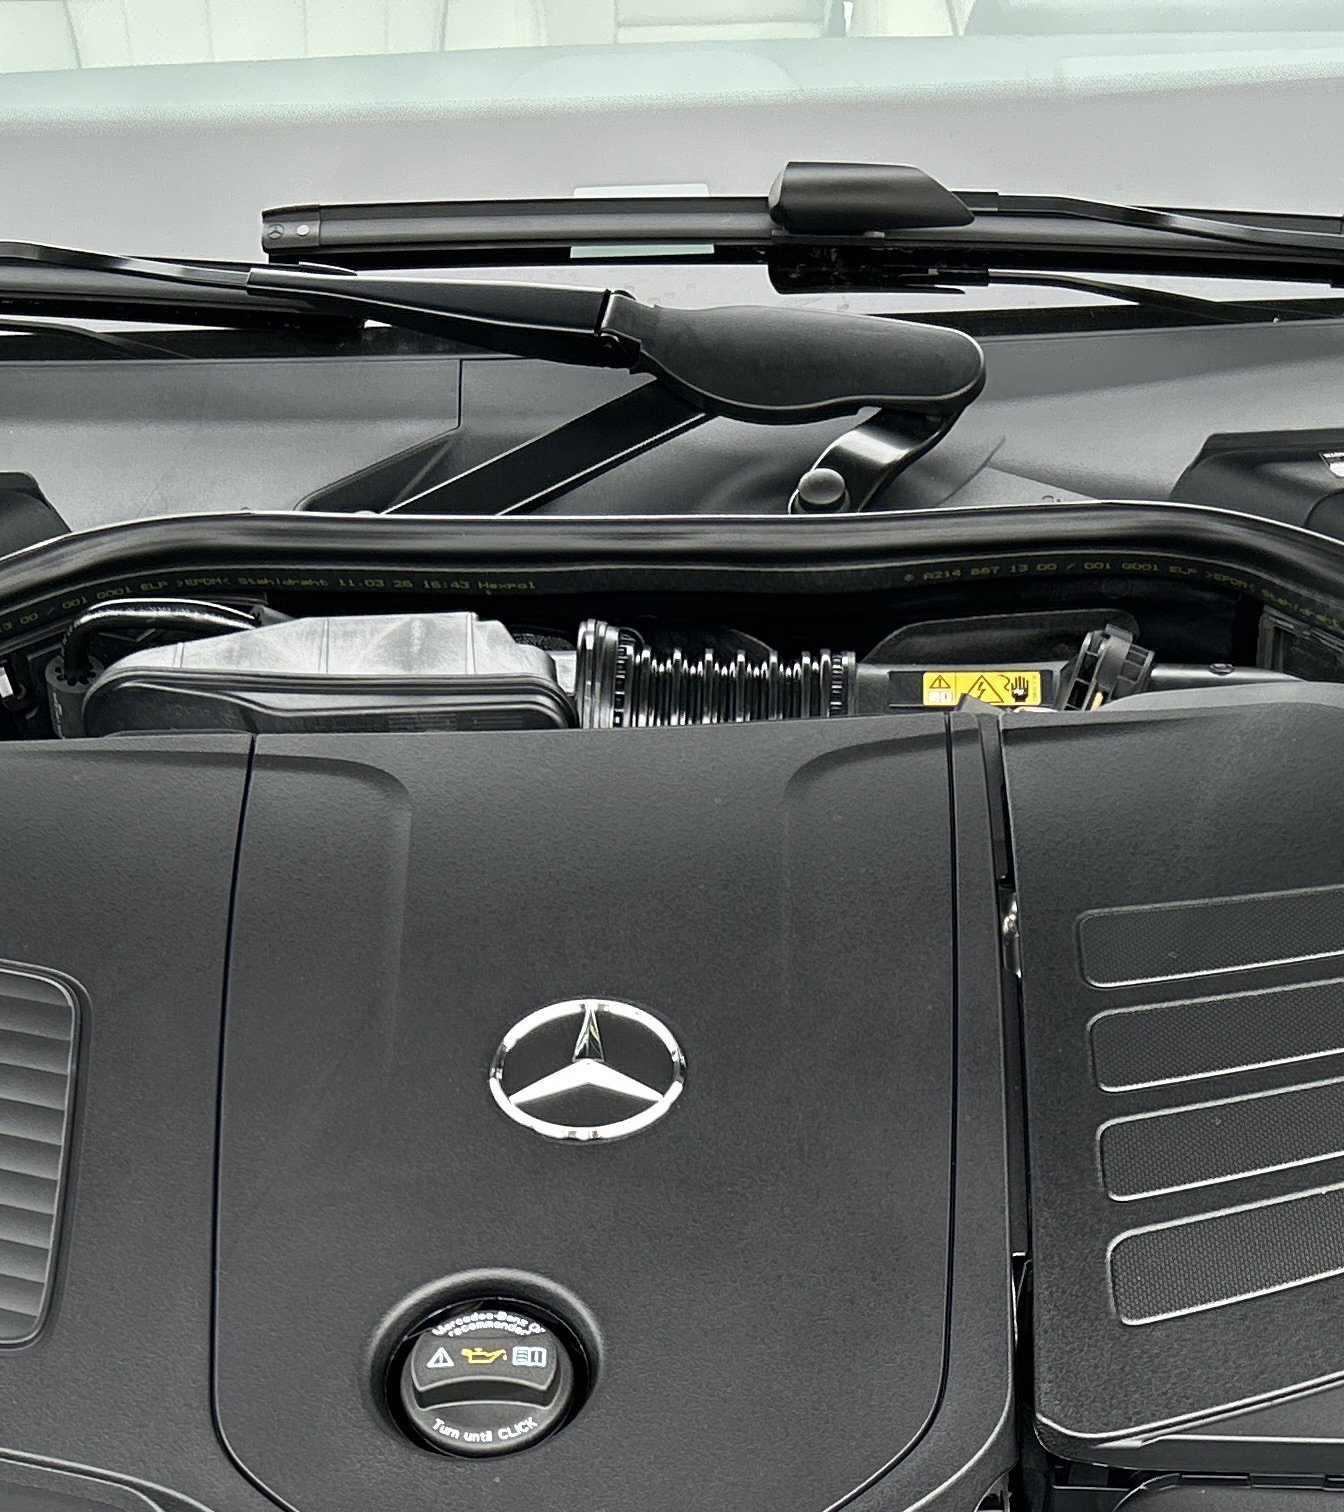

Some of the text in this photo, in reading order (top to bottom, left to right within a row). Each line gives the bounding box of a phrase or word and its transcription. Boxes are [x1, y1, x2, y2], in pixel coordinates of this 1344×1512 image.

[431, 1416, 539, 1443] Turn until CLICK
